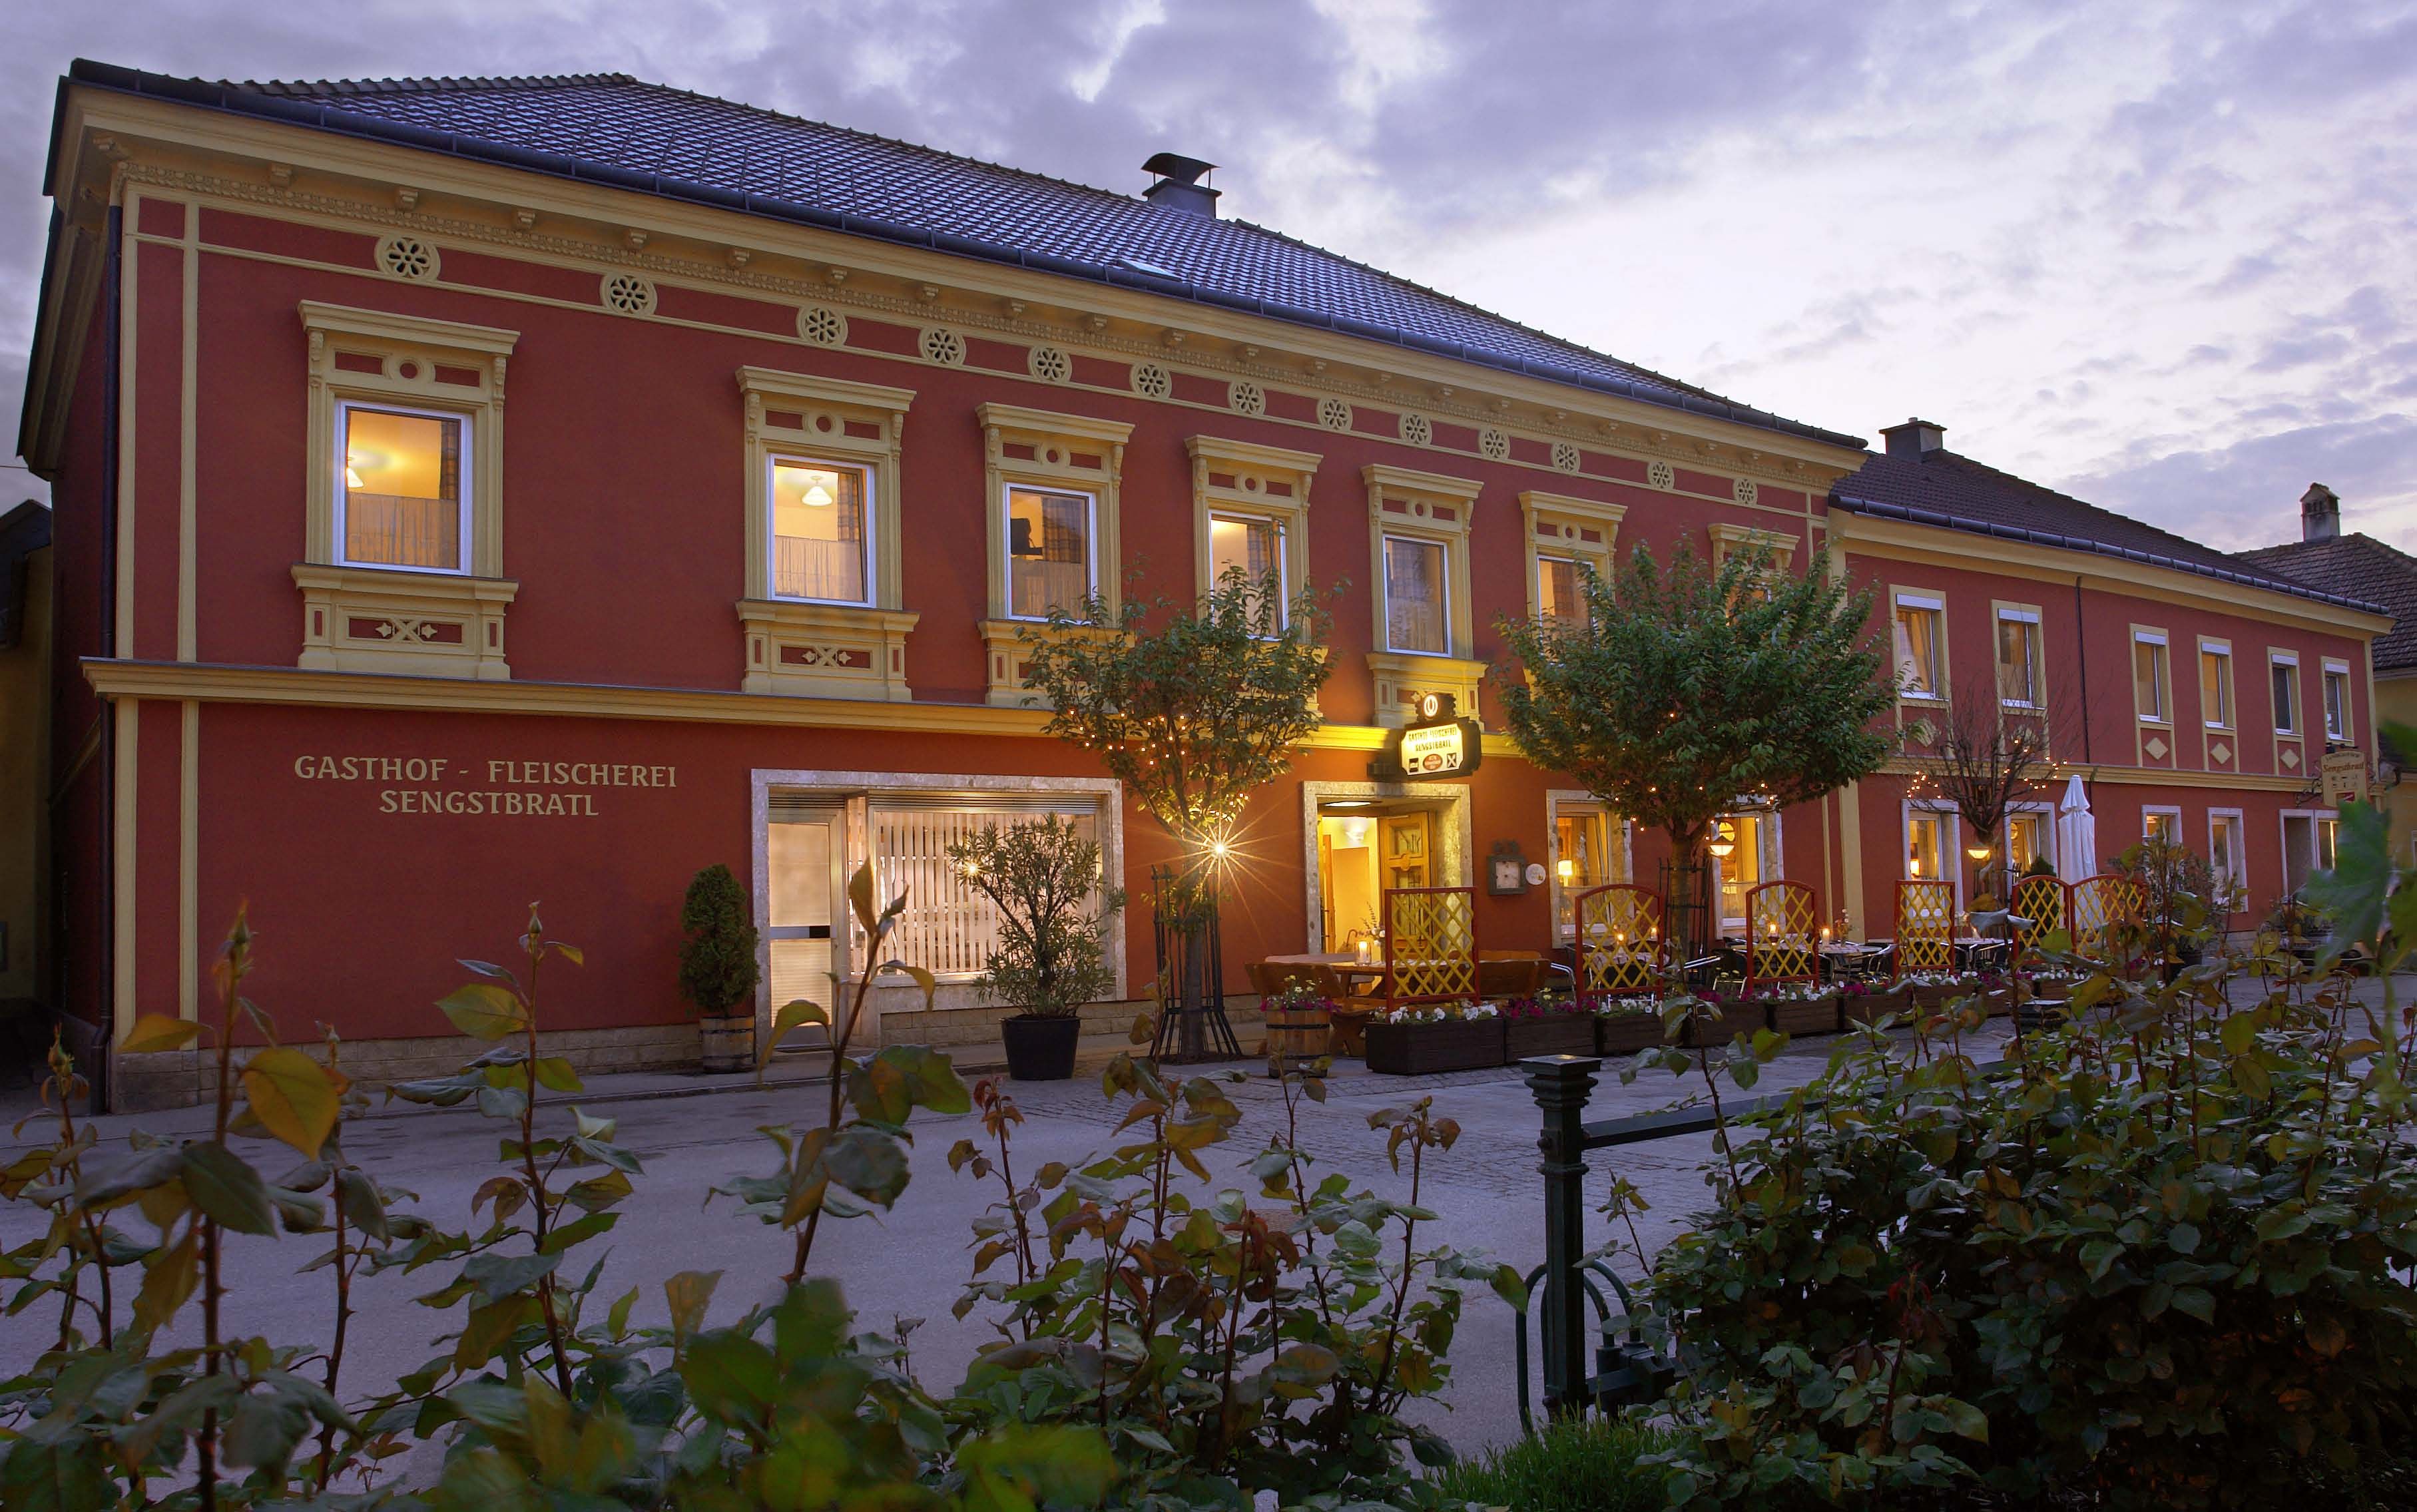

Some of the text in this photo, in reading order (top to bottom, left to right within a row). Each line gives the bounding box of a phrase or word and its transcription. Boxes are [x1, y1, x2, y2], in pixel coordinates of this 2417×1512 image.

[294, 755, 449, 782] GASTHOF
[487, 760, 677, 788] FLEISCHEREI
[379, 790, 600, 816] SENGSTBRATL
